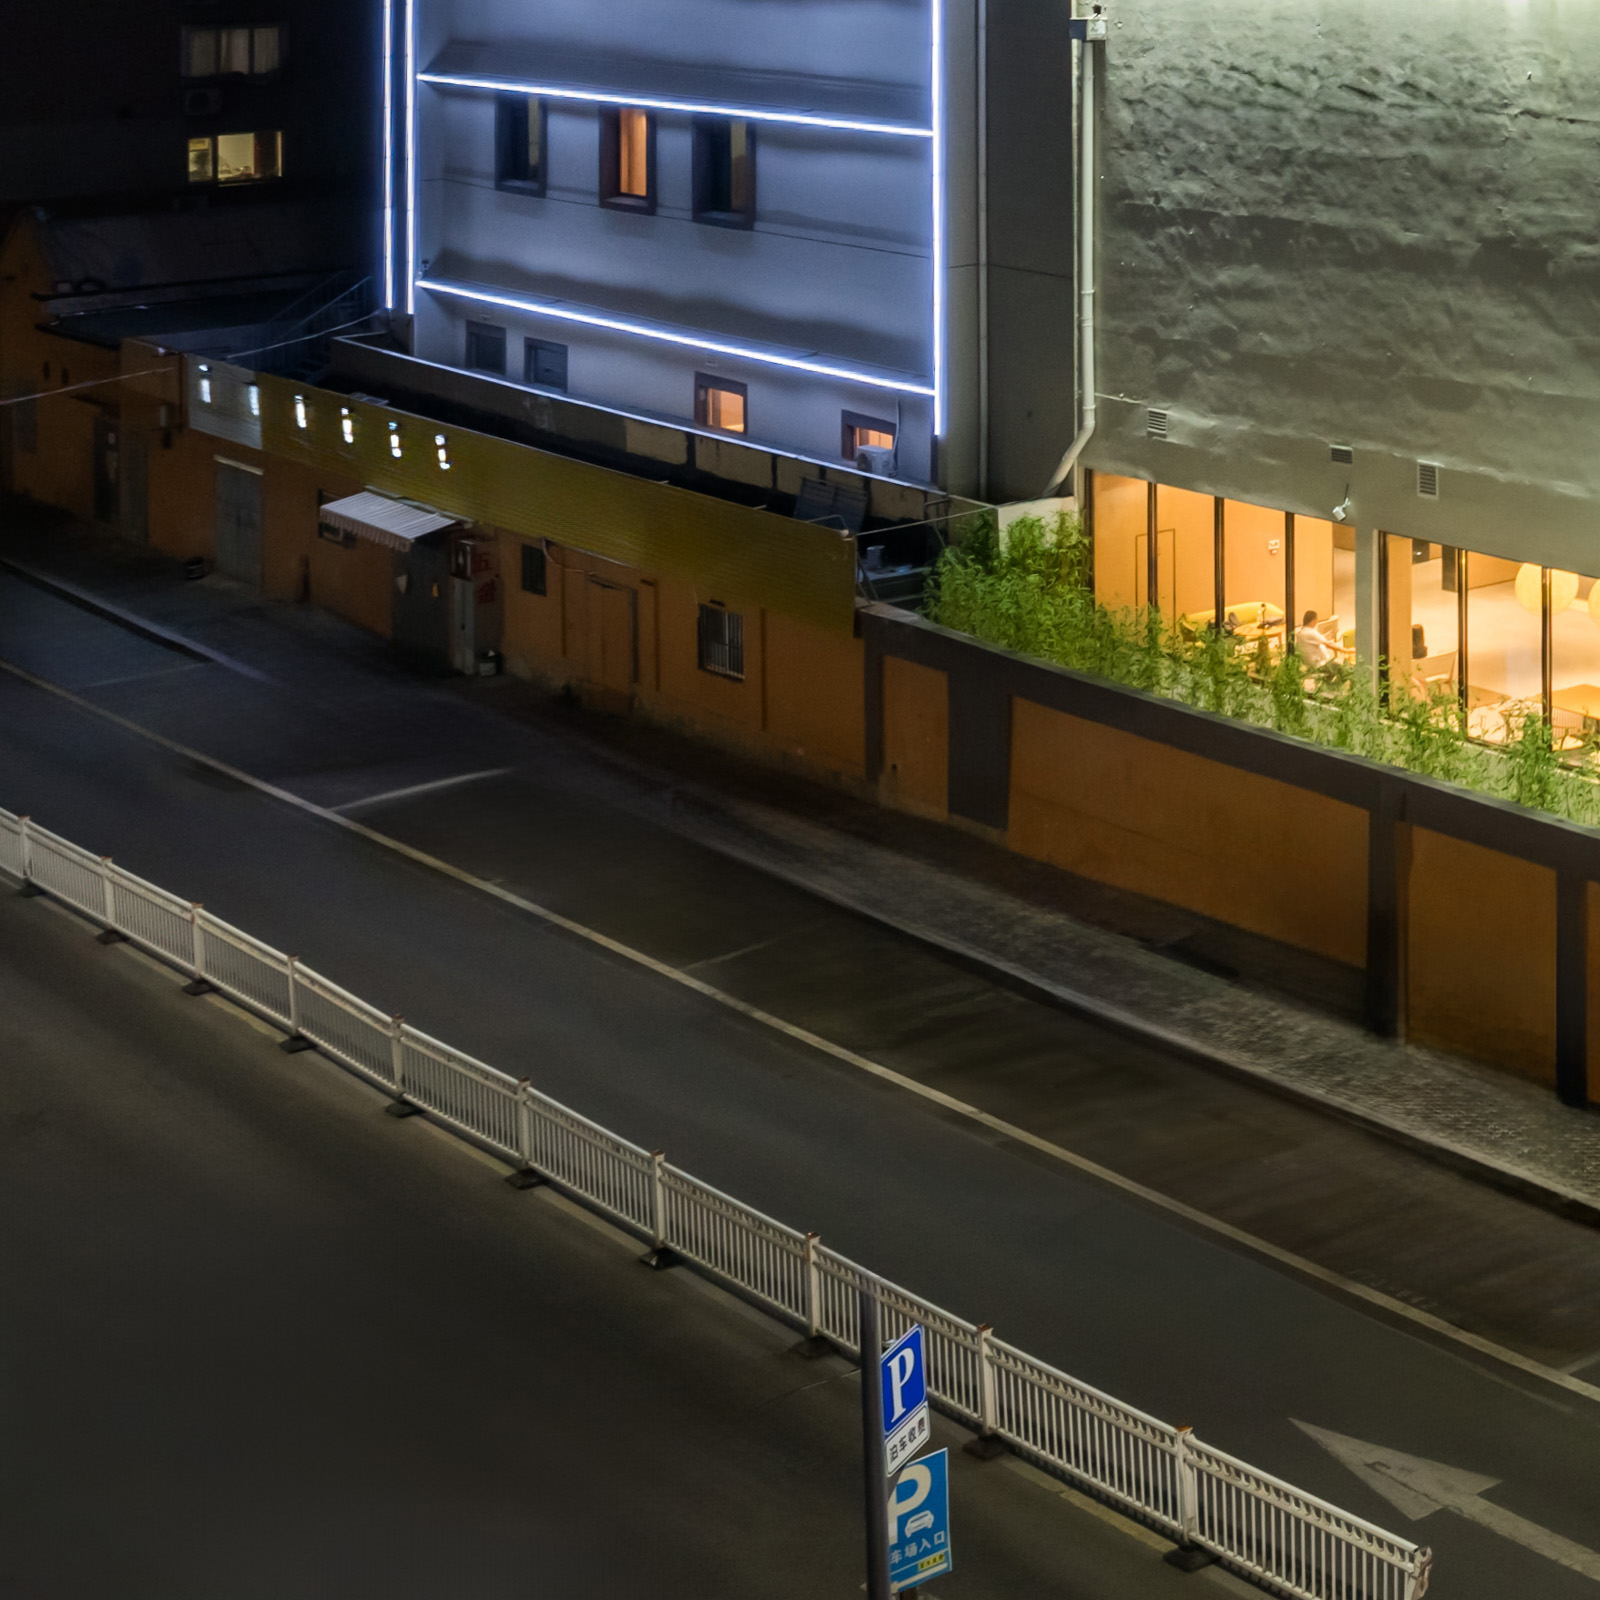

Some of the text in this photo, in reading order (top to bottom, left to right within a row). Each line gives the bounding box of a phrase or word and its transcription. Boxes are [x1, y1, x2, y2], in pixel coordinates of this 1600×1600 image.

[887, 1347, 915, 1424] P
[889, 1418, 926, 1463] 泊车收费
[888, 1464, 932, 1546] P
[890, 1531, 945, 1565] 车场入口
